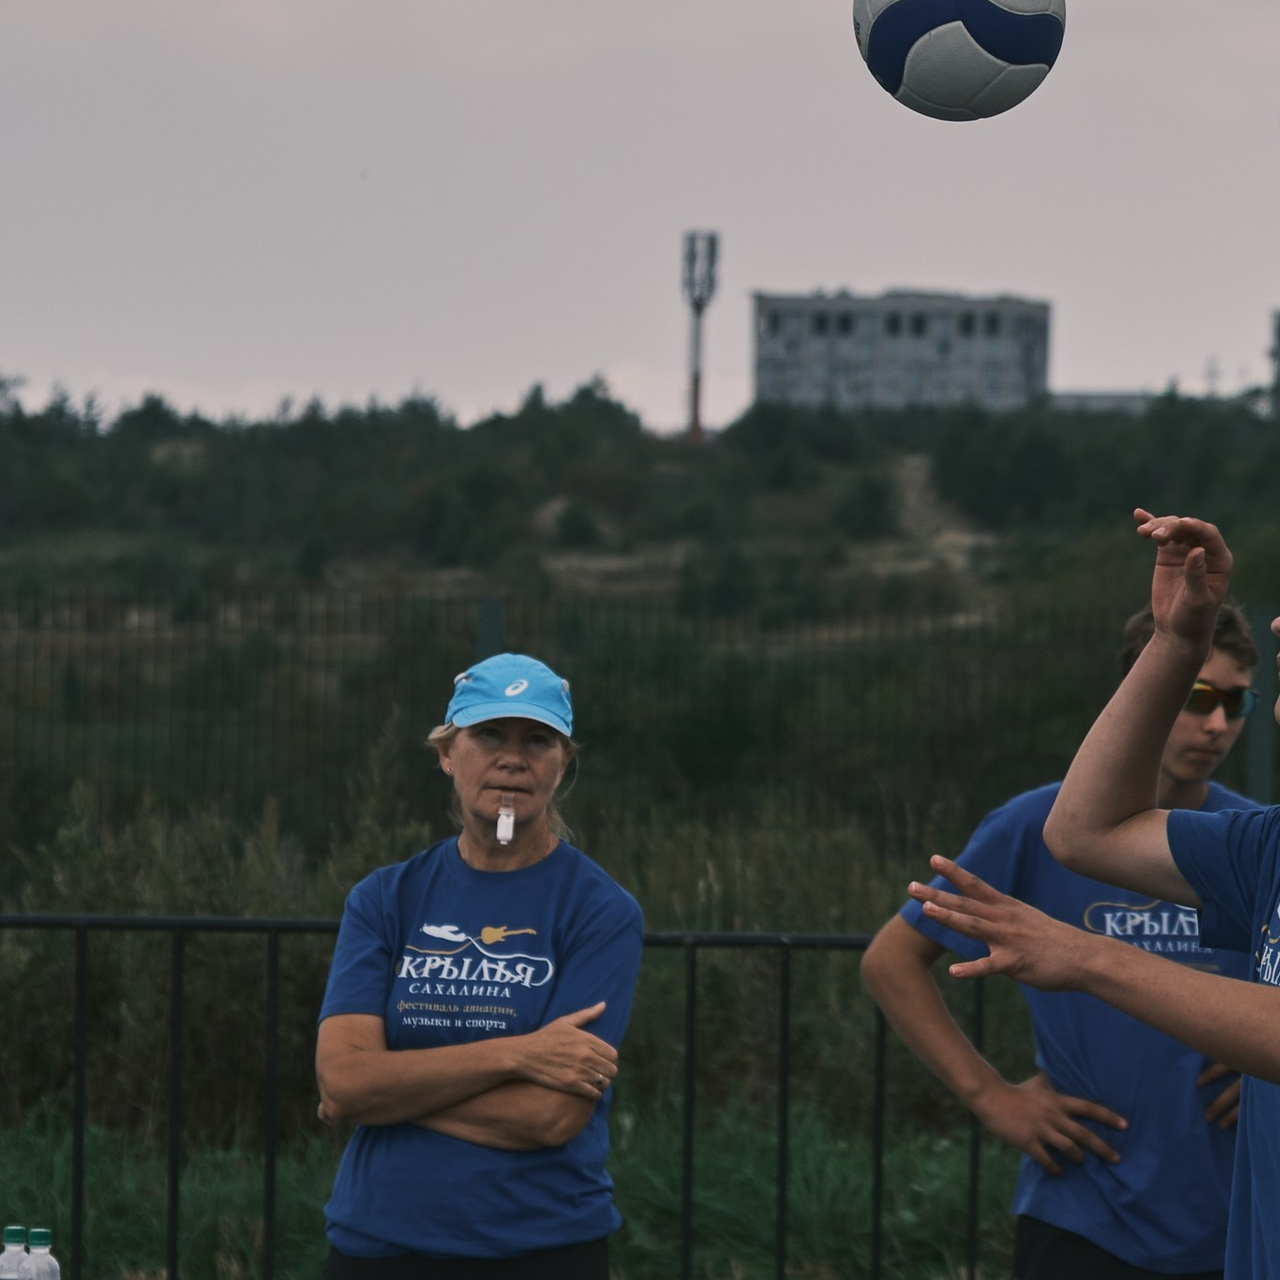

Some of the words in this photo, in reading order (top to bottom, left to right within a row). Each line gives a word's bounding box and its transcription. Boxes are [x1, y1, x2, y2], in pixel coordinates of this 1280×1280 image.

[1133, 941, 1213, 954] ХАЛИН
[397, 955, 535, 988] КРЫЛЬЯ
[408, 982, 511, 999] САХАЛИНА
[397, 1000, 459, 1013] фестиваль
[402, 1016, 451, 1030] музыки
[454, 1019, 463, 1028] и
[465, 1018, 507, 1031] спорта
